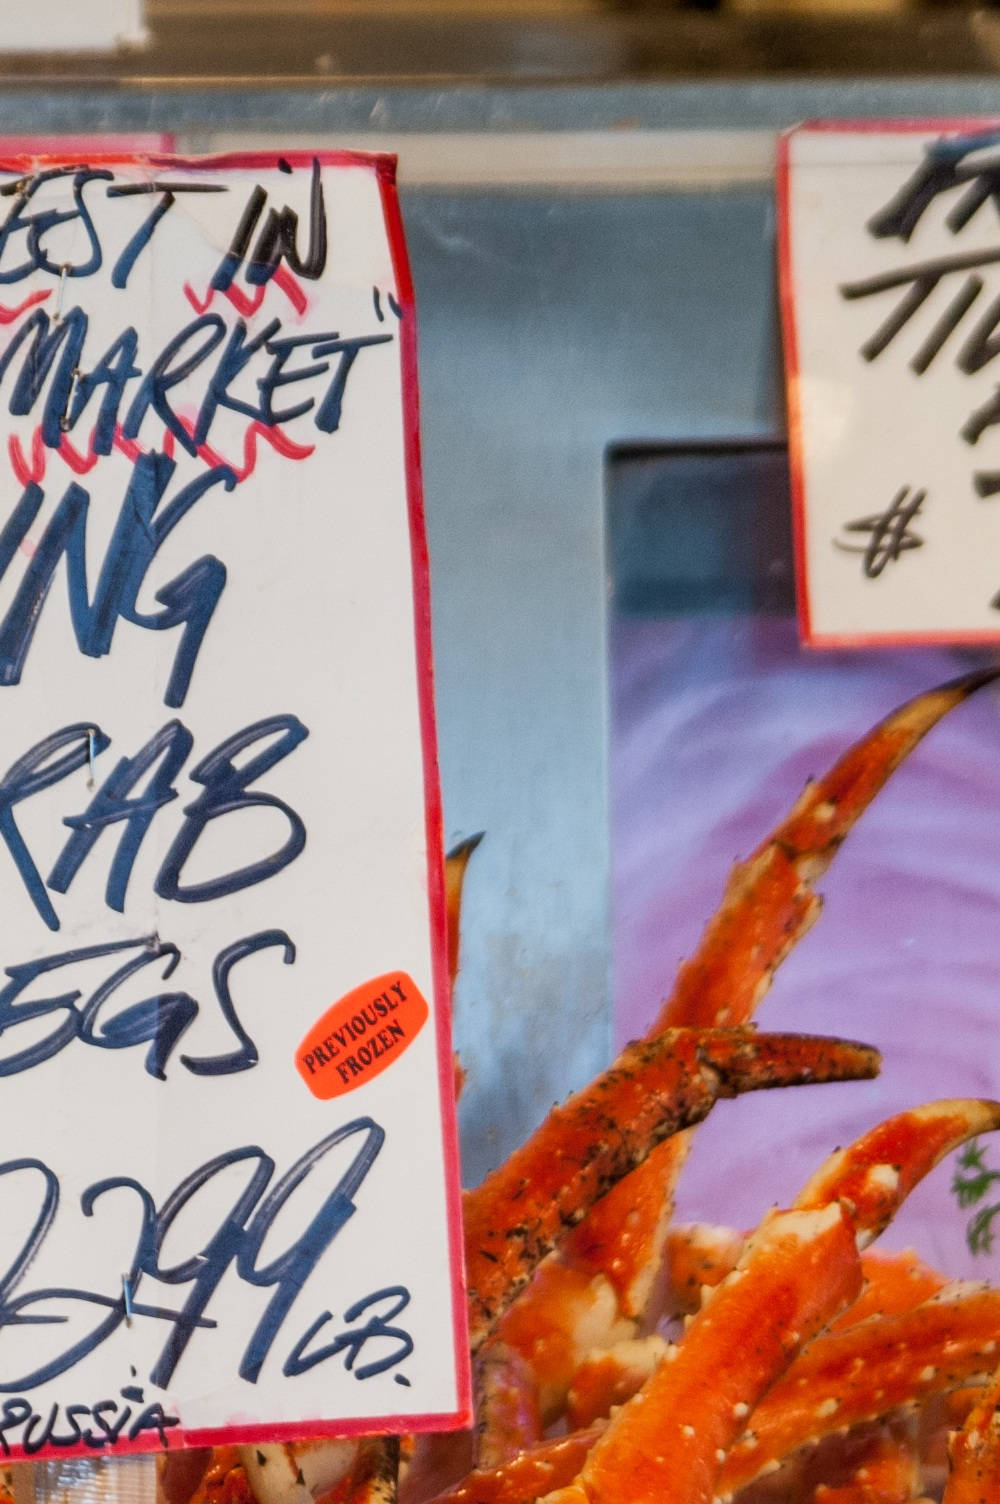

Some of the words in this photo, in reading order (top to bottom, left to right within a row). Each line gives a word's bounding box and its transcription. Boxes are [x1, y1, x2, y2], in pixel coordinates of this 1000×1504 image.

[210, 157, 328, 292] IN
[303, 980, 408, 1075] PREVIOUSLY
[336, 1019, 406, 1085] FROZEN
